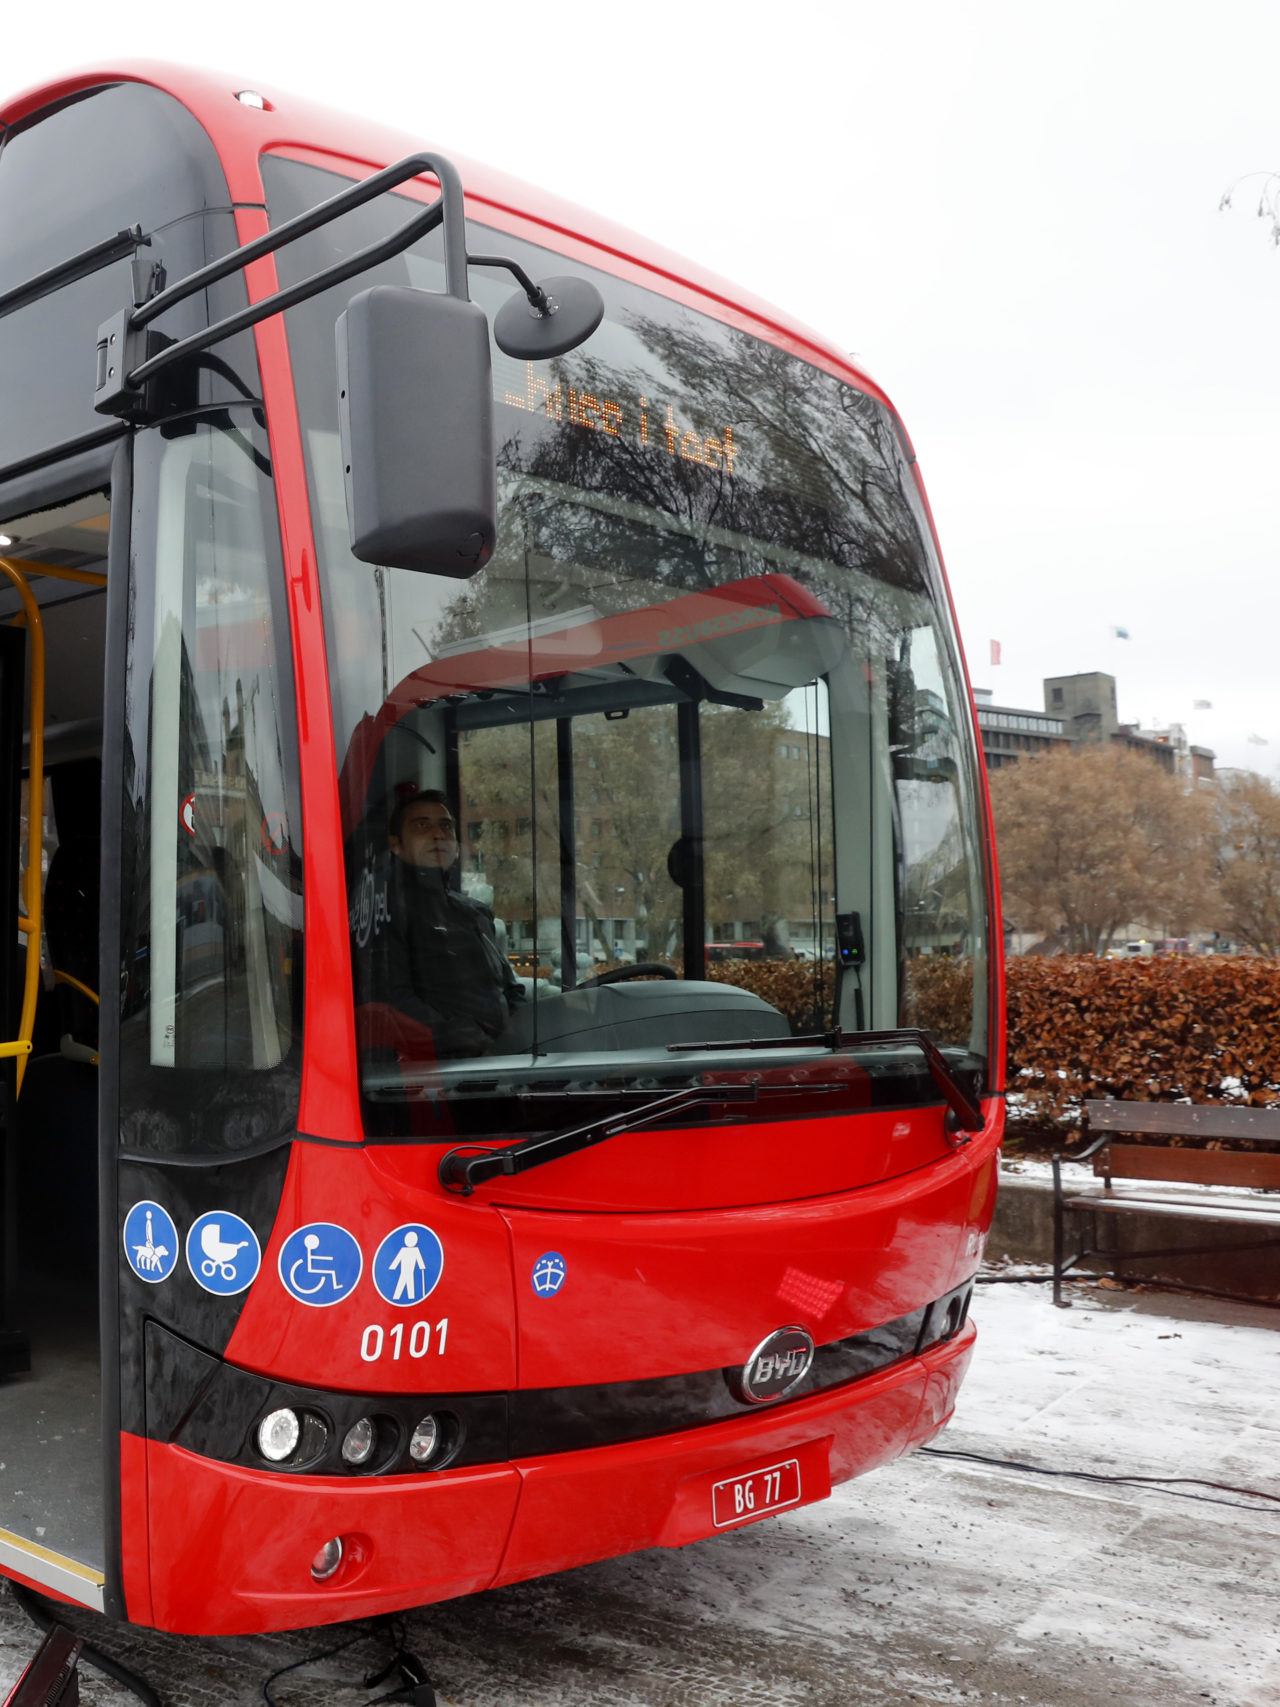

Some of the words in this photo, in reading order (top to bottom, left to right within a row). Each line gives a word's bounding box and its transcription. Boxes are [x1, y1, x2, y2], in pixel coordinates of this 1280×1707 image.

[360, 1317, 449, 1362] 0101
[752, 1347, 808, 1385] BYD
[734, 1479, 756, 1514] BG
[763, 1471, 782, 1504] 77
